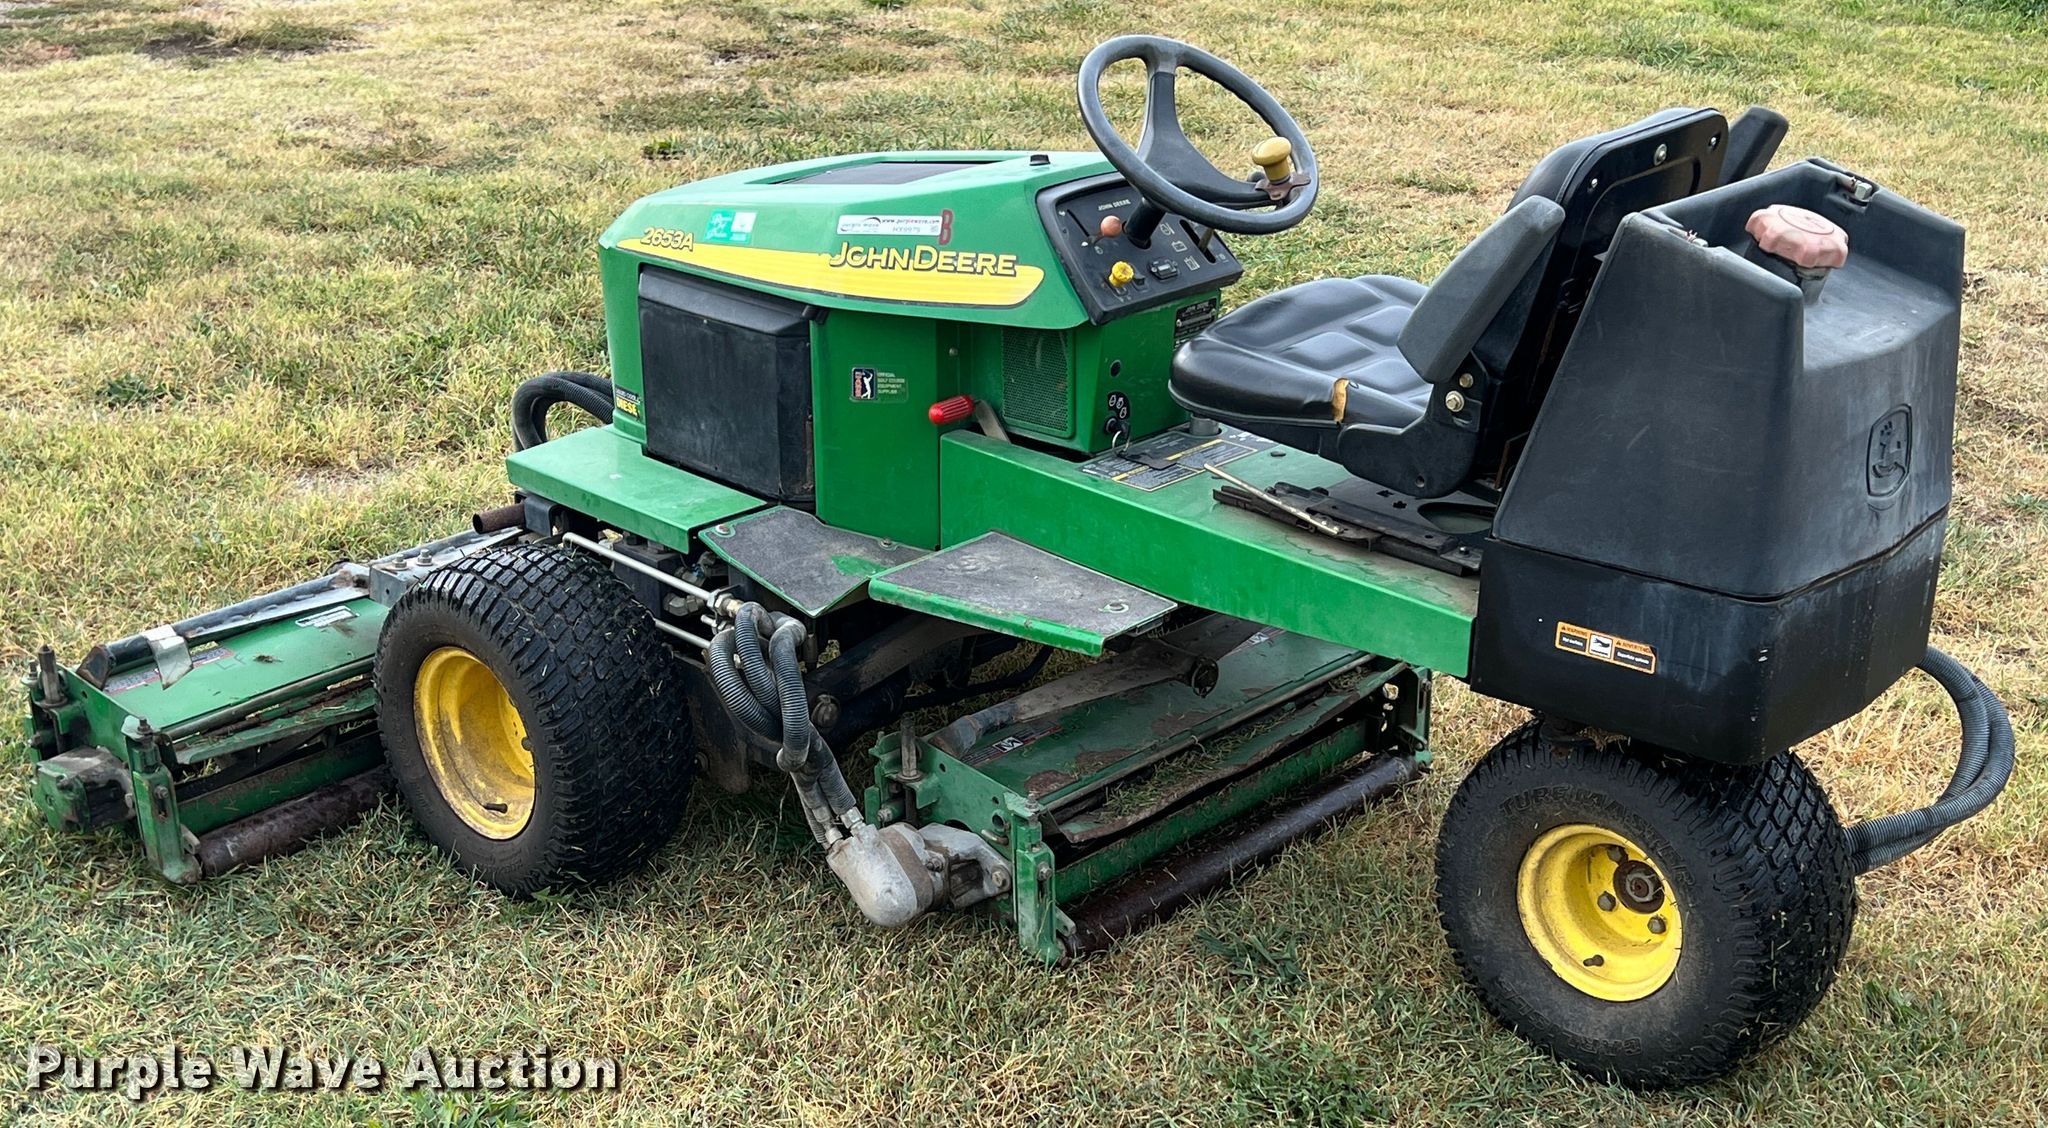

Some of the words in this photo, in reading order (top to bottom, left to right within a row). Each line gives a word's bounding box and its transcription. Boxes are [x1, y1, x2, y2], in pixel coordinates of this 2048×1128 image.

[640, 227, 694, 252] 2653A
[939, 209, 953, 245] B
[829, 242, 909, 269] JOHN
[912, 244, 1016, 276] DEERE
[616, 396, 638, 417] DIESE
